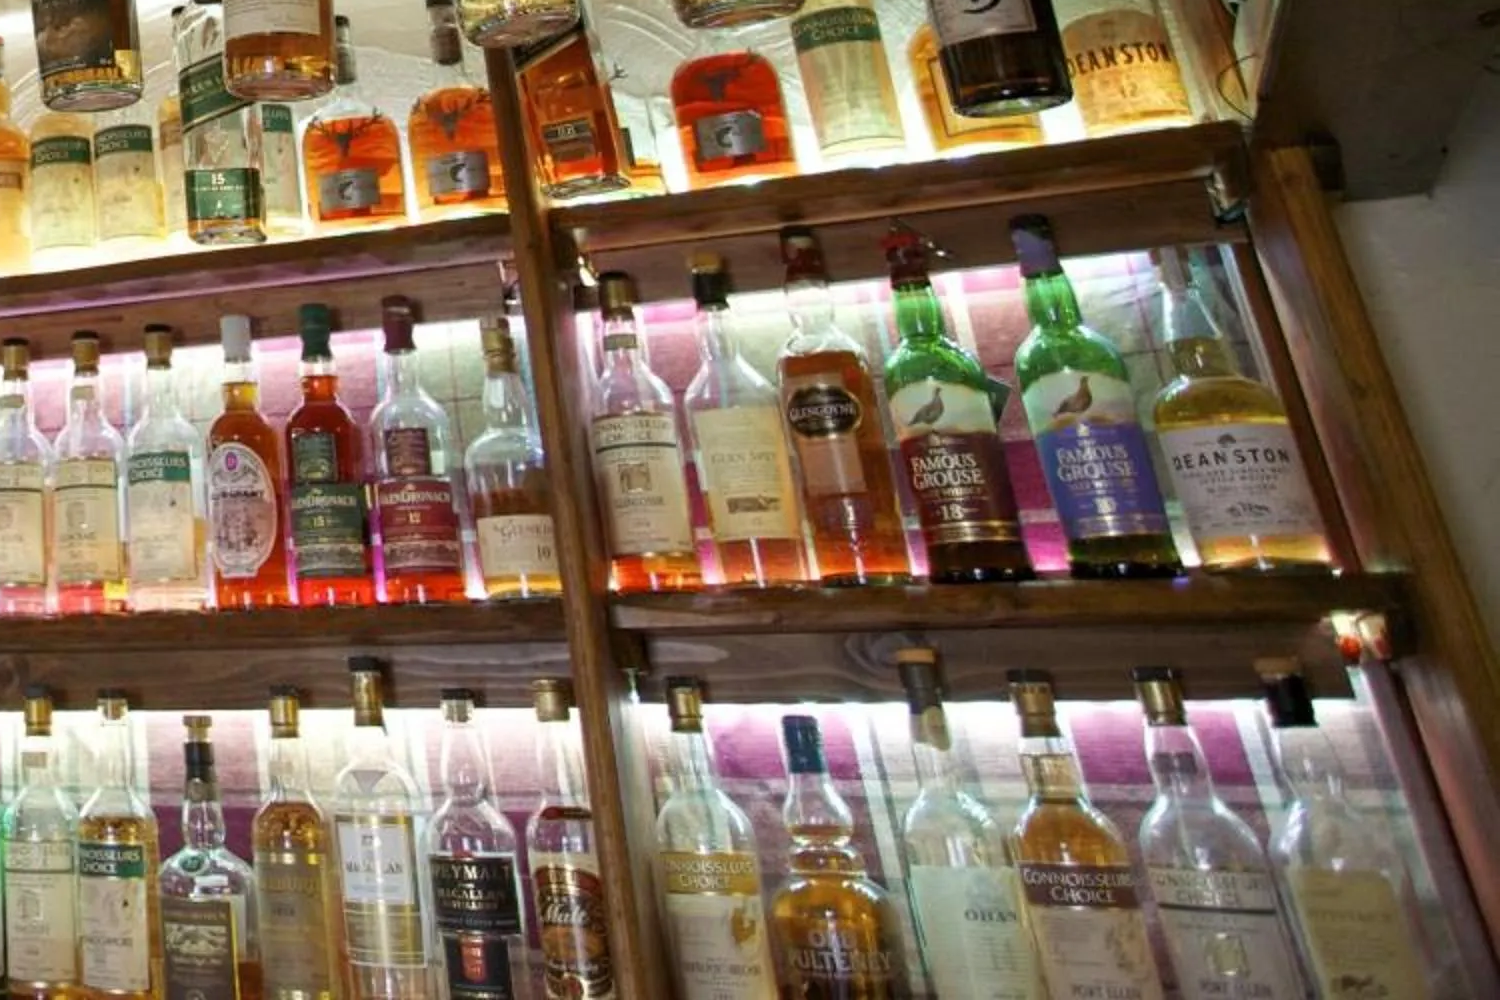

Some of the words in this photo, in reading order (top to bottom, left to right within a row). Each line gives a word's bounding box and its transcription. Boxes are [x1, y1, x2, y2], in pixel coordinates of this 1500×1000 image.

[1067, 40, 1172, 78] DEANSTON
[911, 452, 977, 473] FAMOUS
[1056, 444, 1129, 465] FAMOUS
[1172, 447, 1291, 472] DEANSTON
[912, 466, 985, 491] GROUSE
[1058, 459, 1138, 483] GROUSE
[1050, 887, 1115, 904] CHOICE
[790, 949, 893, 973] PULTENEY
